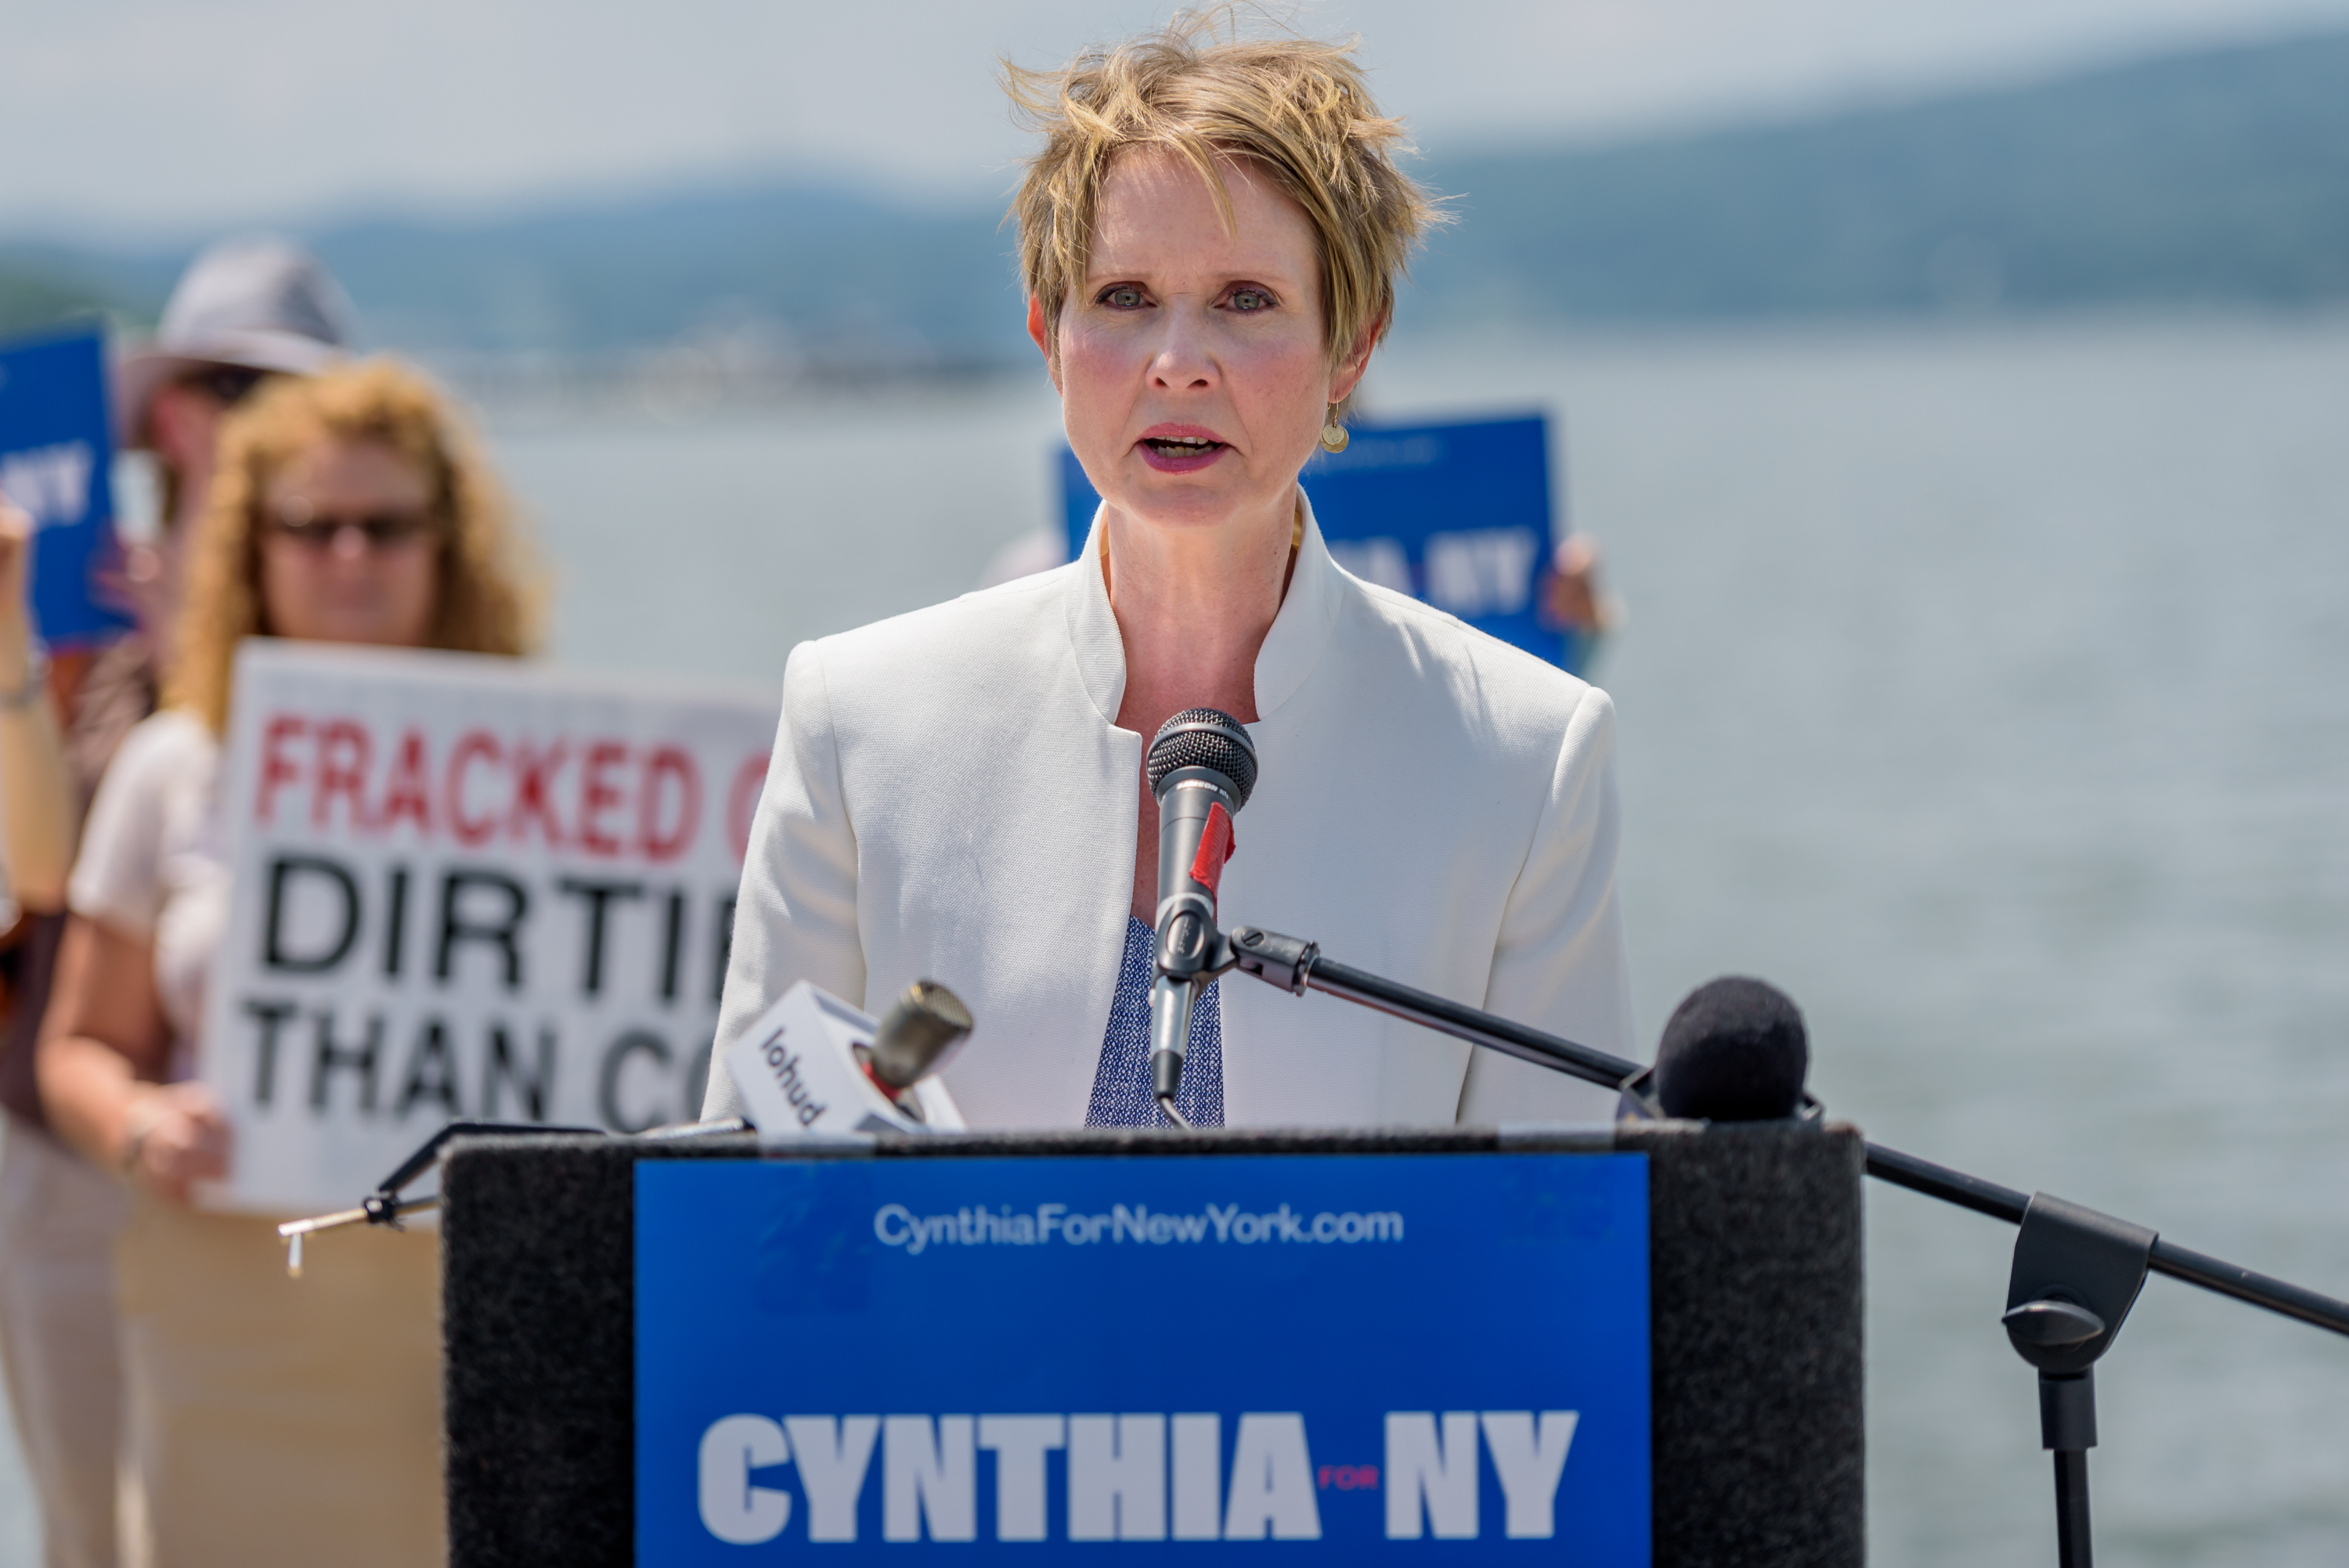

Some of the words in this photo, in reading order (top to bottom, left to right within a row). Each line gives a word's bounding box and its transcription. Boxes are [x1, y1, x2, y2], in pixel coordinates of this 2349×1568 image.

[254, 712, 707, 867] FRACKED
[1176, 780, 1218, 792] SAMSON
[239, 1000, 557, 1123] THAN
[760, 1026, 827, 1129] lohud
[873, 1202, 1404, 1256] CynthiaForNewYork.com
[697, 1412, 1323, 1545] CYNTHIA
[1317, 1464, 1380, 1491] FOR
[1384, 1410, 1580, 1540] NY
